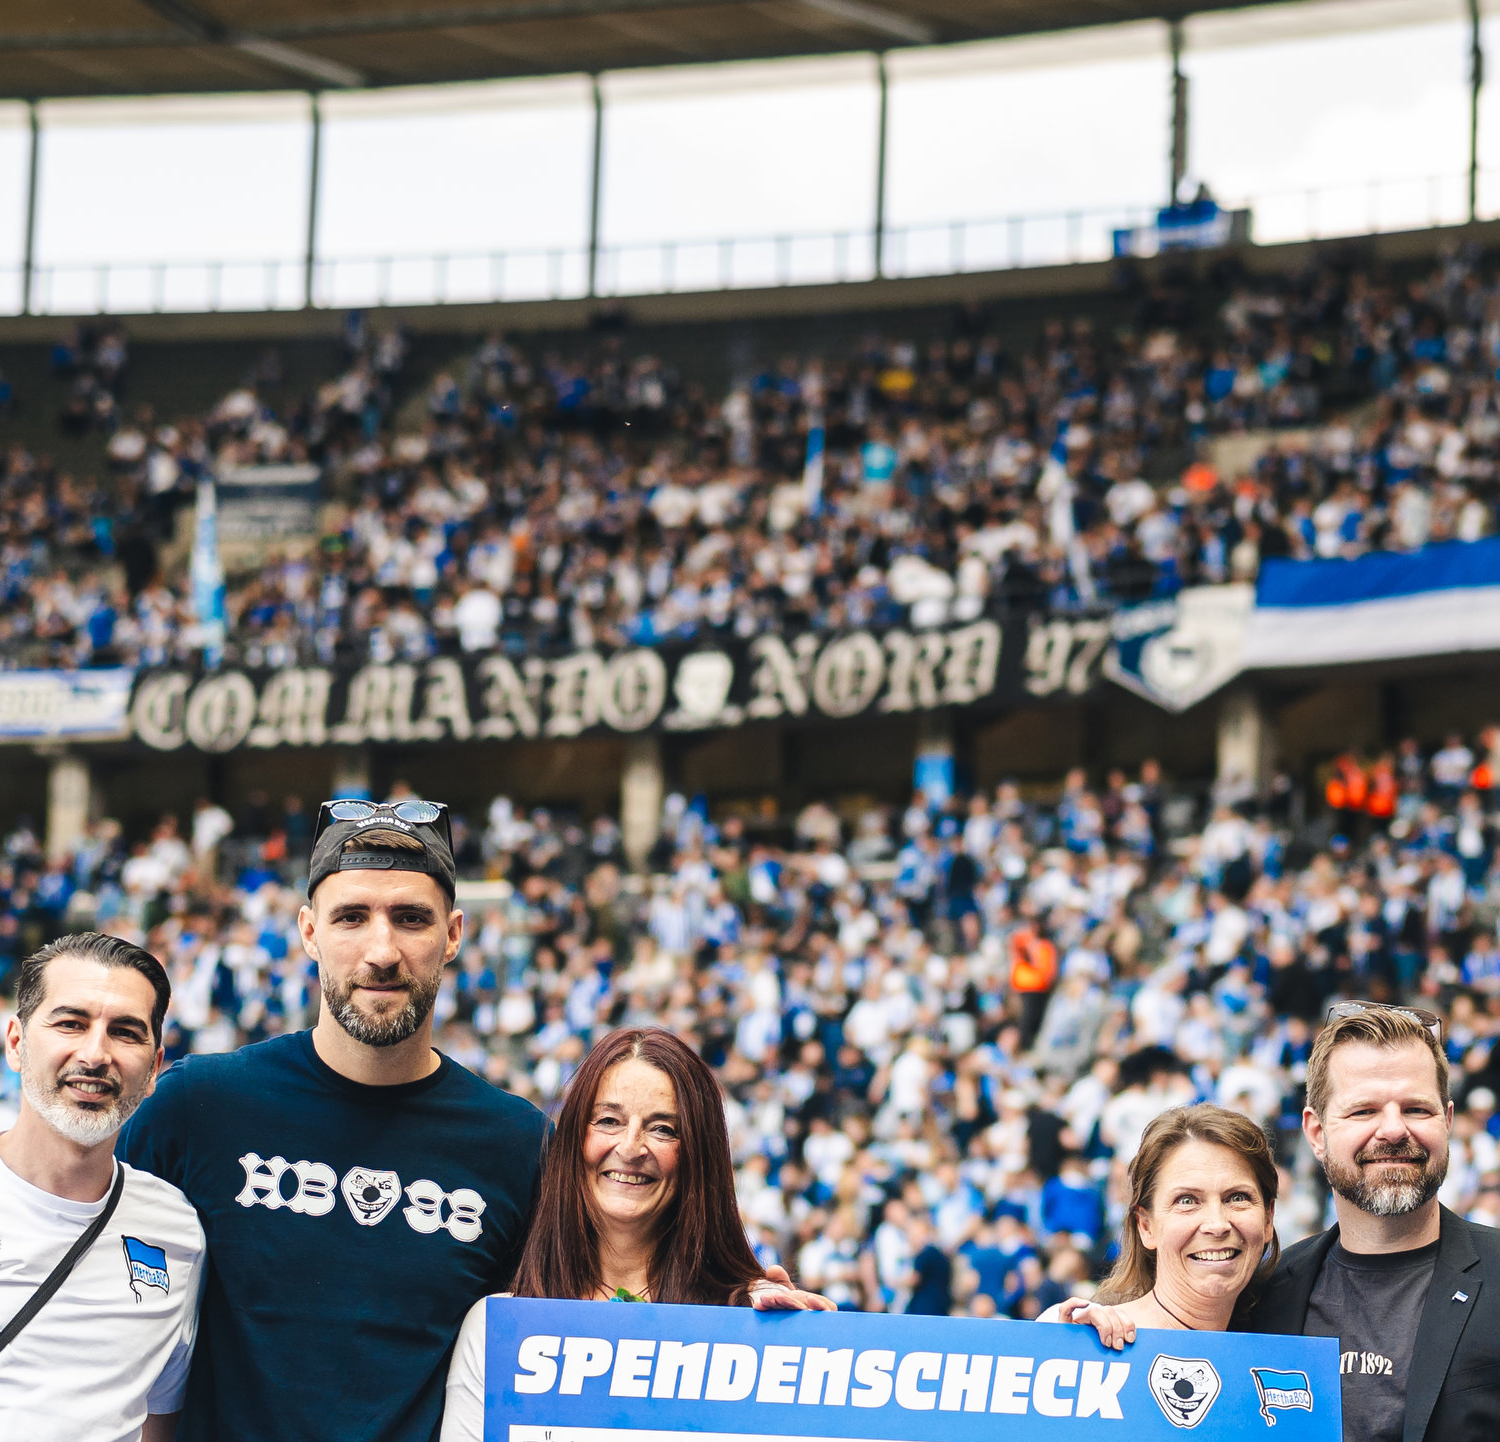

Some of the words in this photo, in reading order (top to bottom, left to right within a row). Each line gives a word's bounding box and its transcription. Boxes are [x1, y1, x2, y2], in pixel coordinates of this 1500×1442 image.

[132, 649, 666, 753] COMMANDO
[747, 619, 1001, 718] NORD
[1025, 619, 1104, 696] 97
[356, 817, 394, 828] HERTHA
[235, 1152, 337, 1217] HB
[514, 1335, 1131, 1419] SPENDENSCHECK
[1359, 1351, 1393, 1375] 1892
